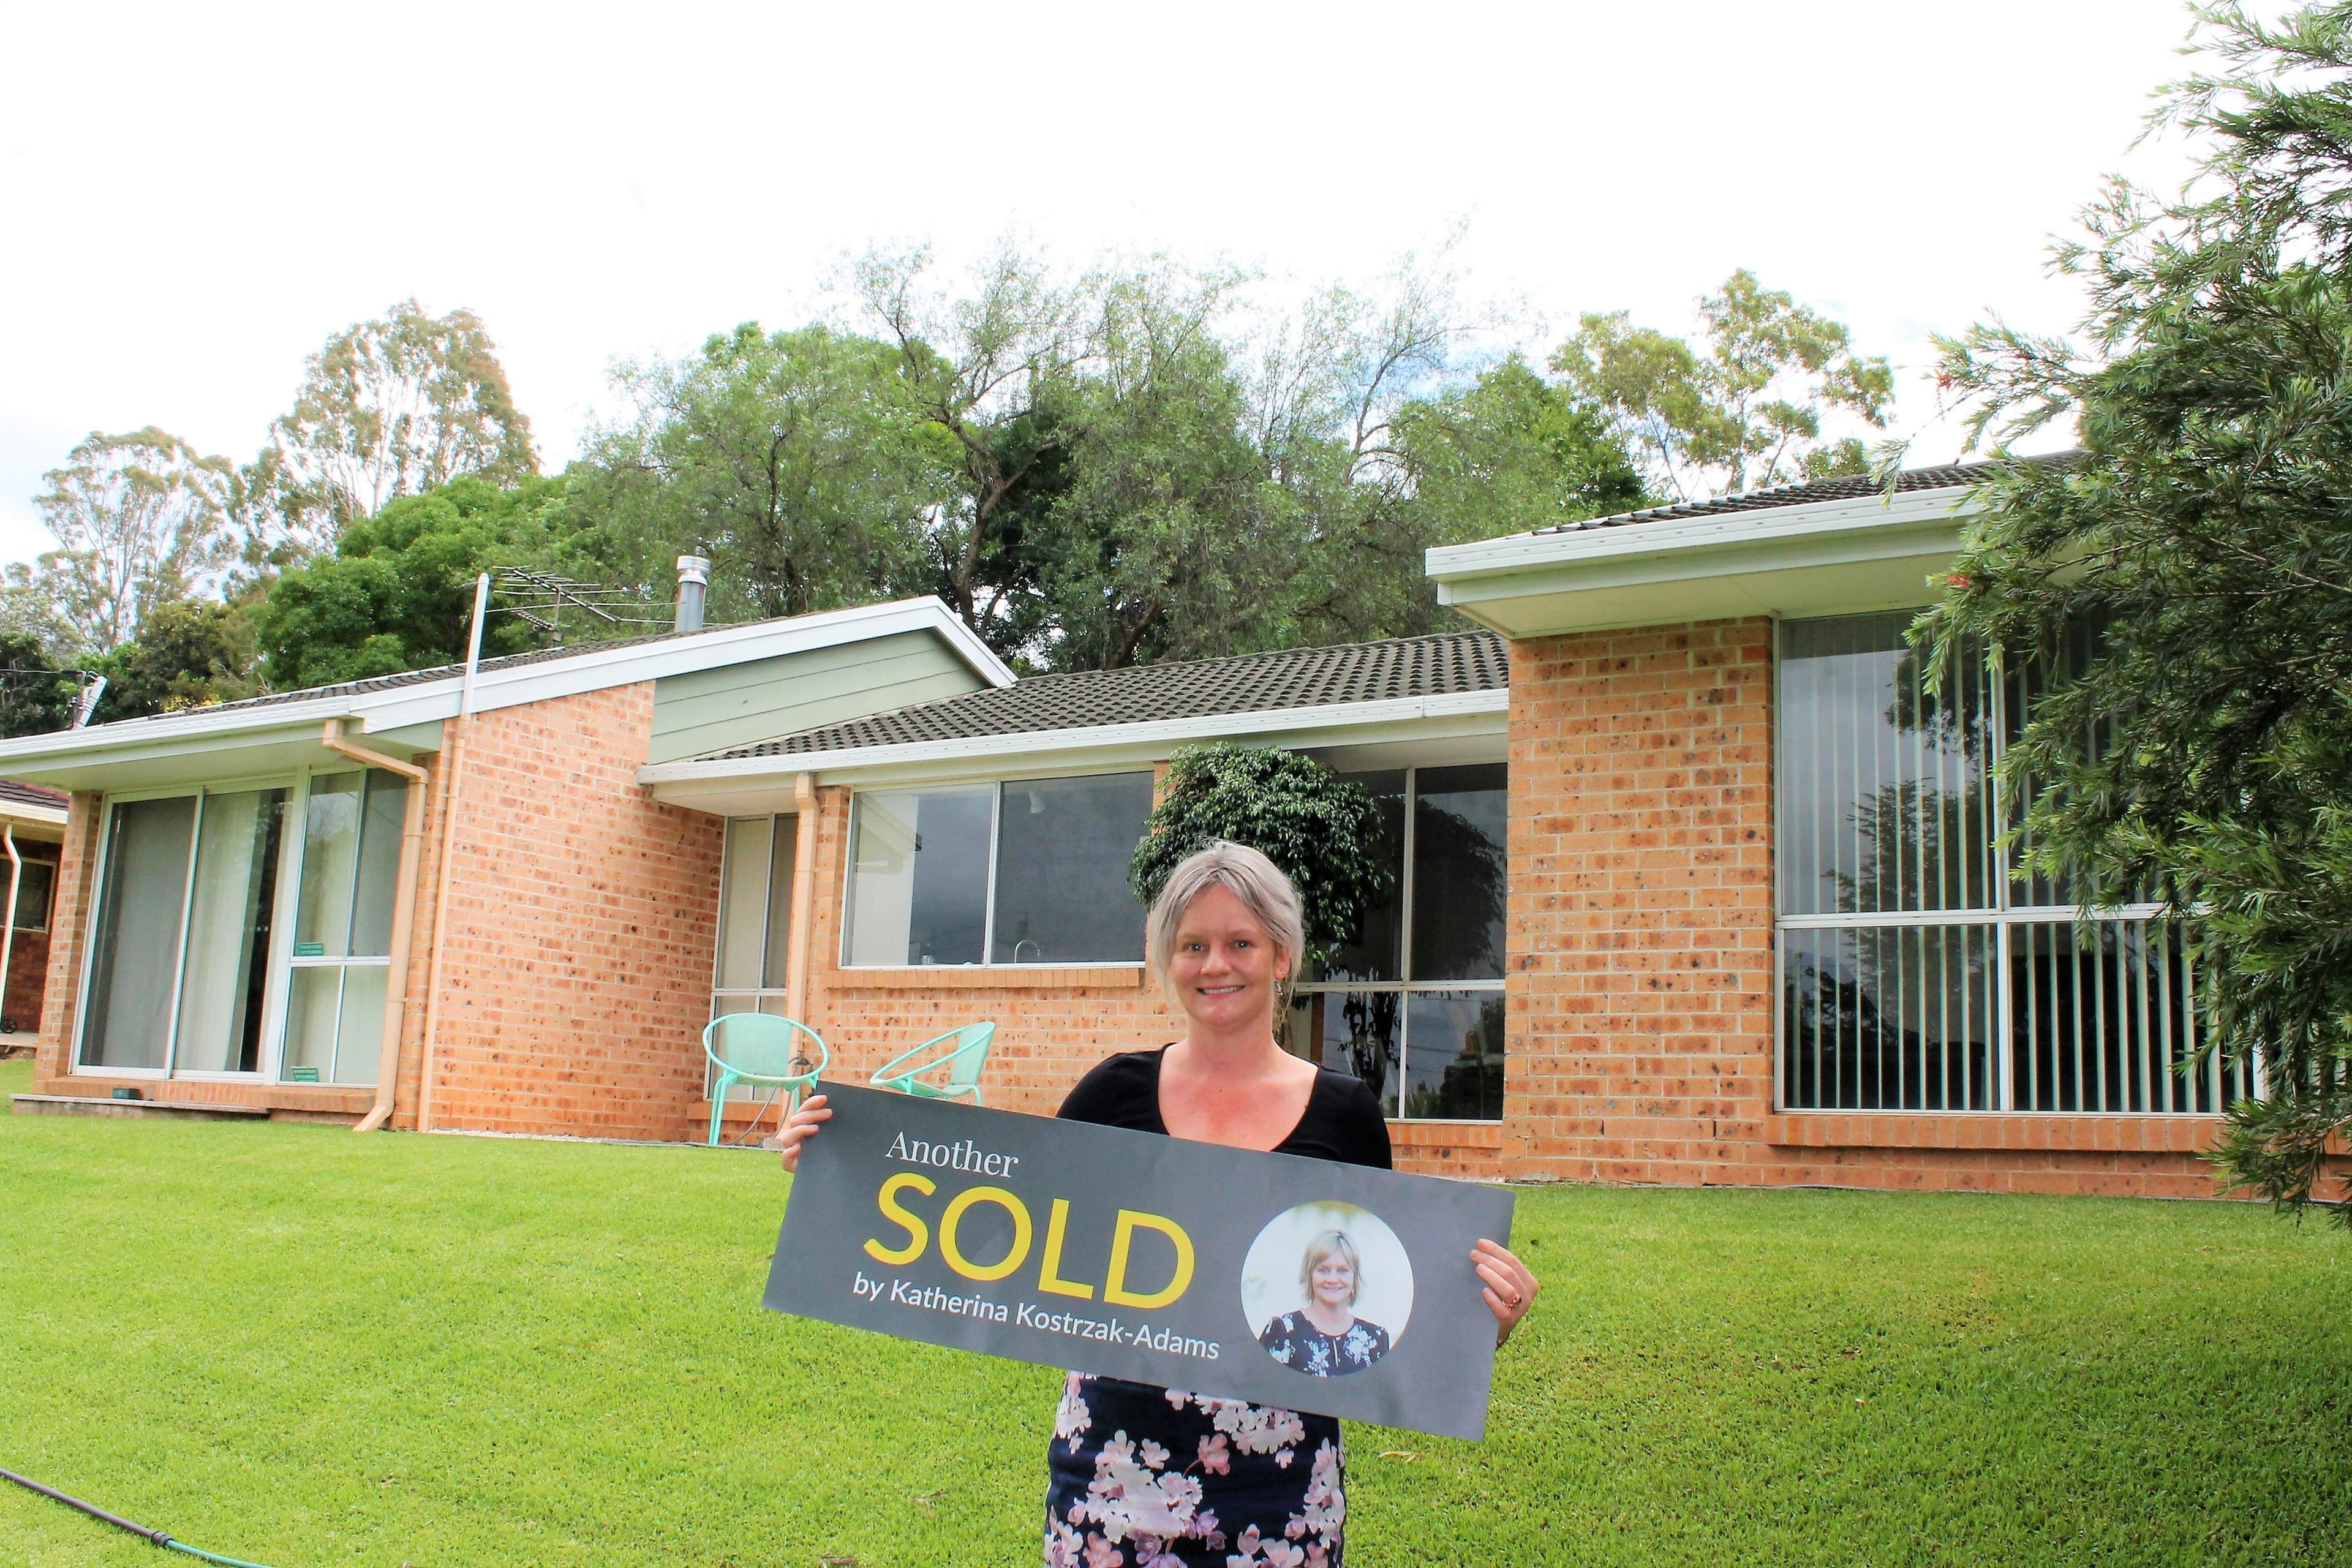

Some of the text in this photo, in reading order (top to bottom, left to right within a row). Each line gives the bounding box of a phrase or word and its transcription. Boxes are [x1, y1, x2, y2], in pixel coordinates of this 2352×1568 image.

[885, 1131, 1020, 1178] Another
[863, 1172, 1195, 1310] SOLD
[853, 1270, 1220, 1360] by Katherina Kostrzak-Adams
